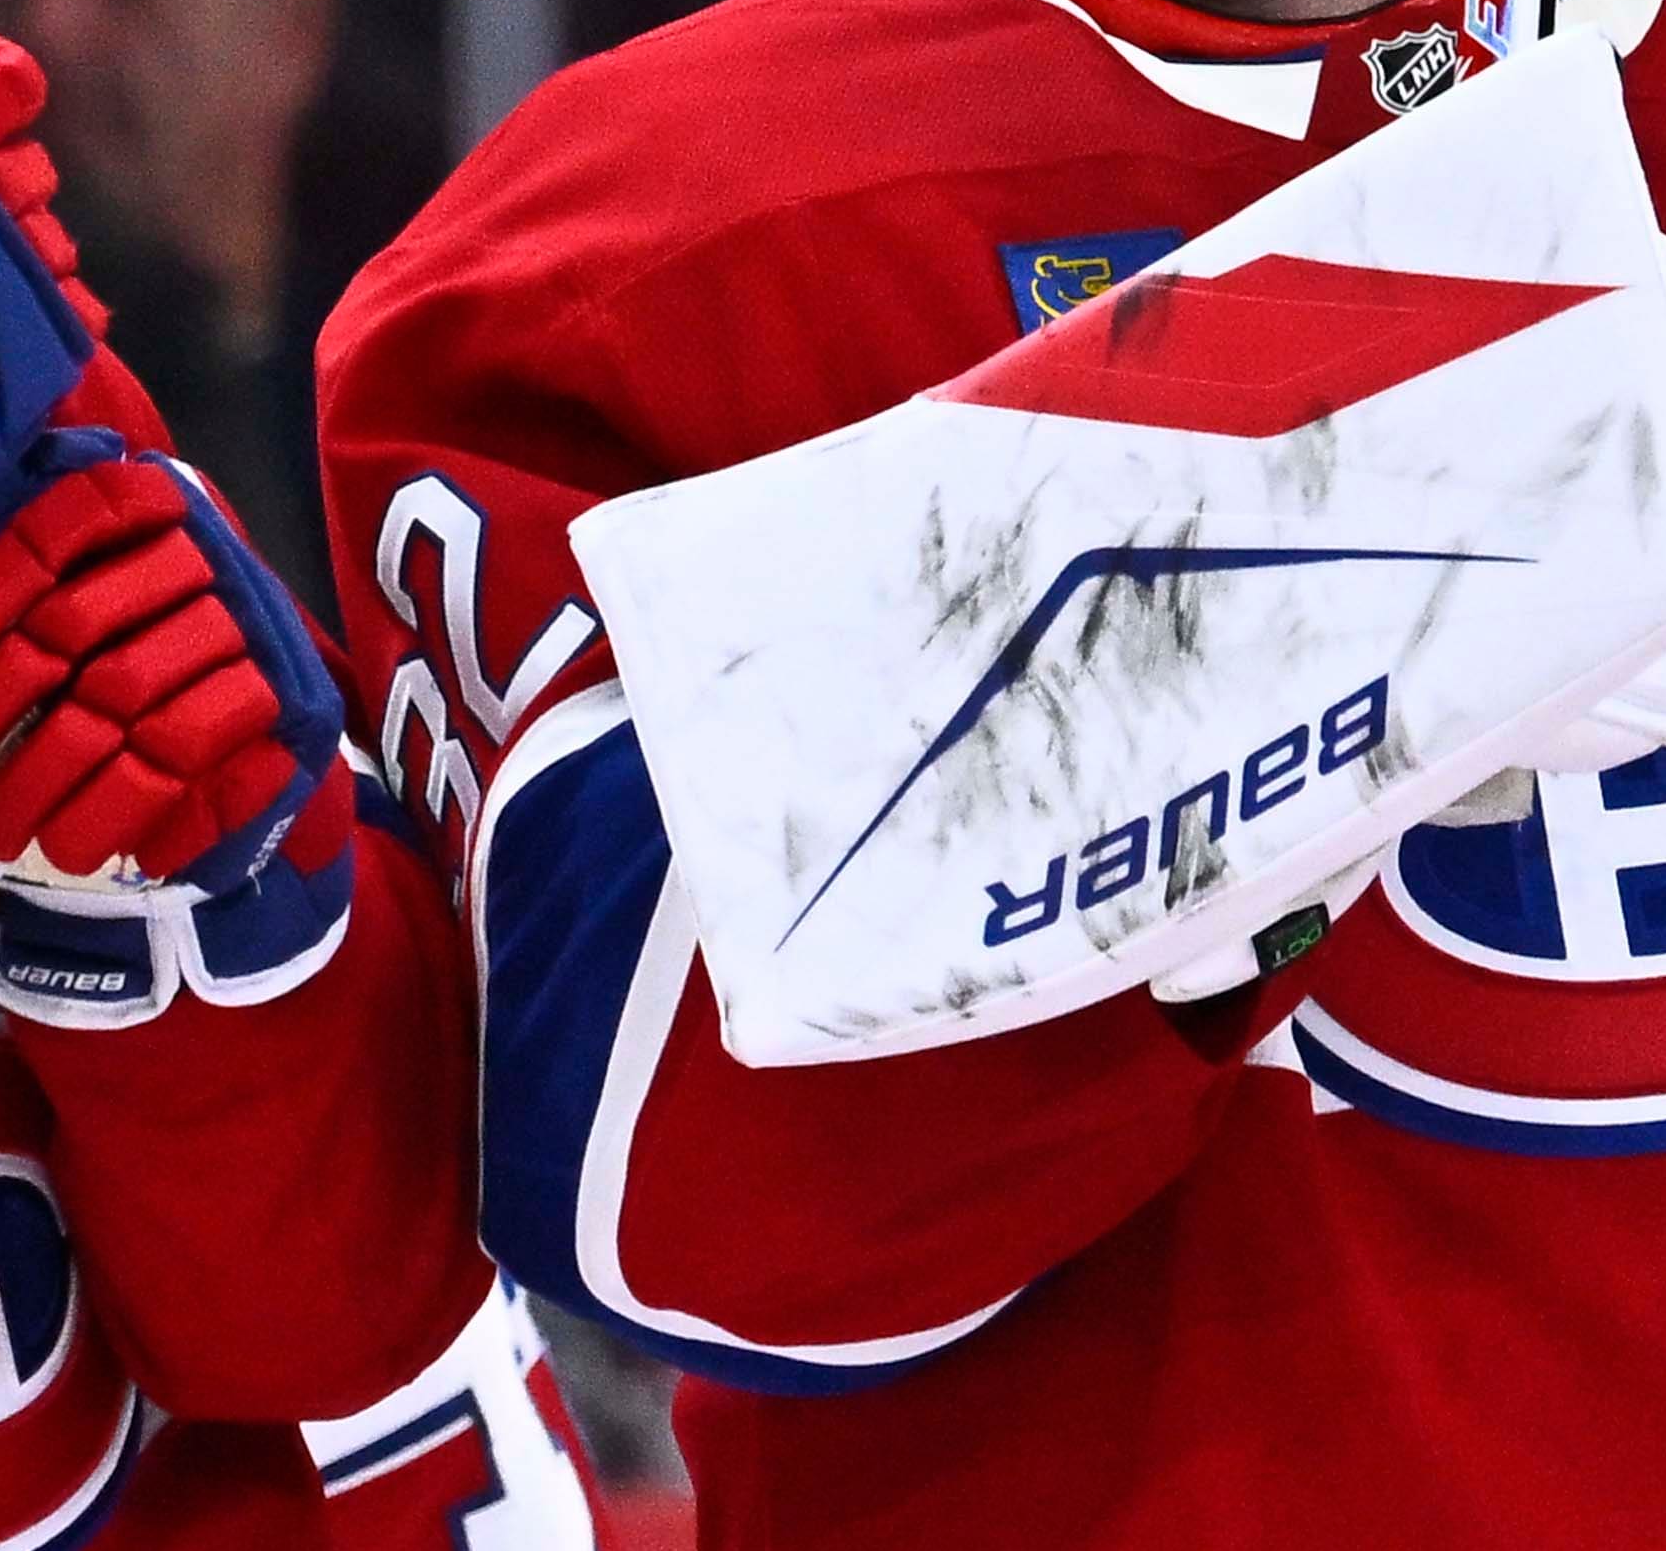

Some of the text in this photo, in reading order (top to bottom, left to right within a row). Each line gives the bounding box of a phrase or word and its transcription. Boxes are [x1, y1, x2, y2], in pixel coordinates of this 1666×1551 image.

[1397, 41, 1447, 102] LNH
[983, 672, 1390, 948] BAUER
[8, 964, 126, 991] BAUER
